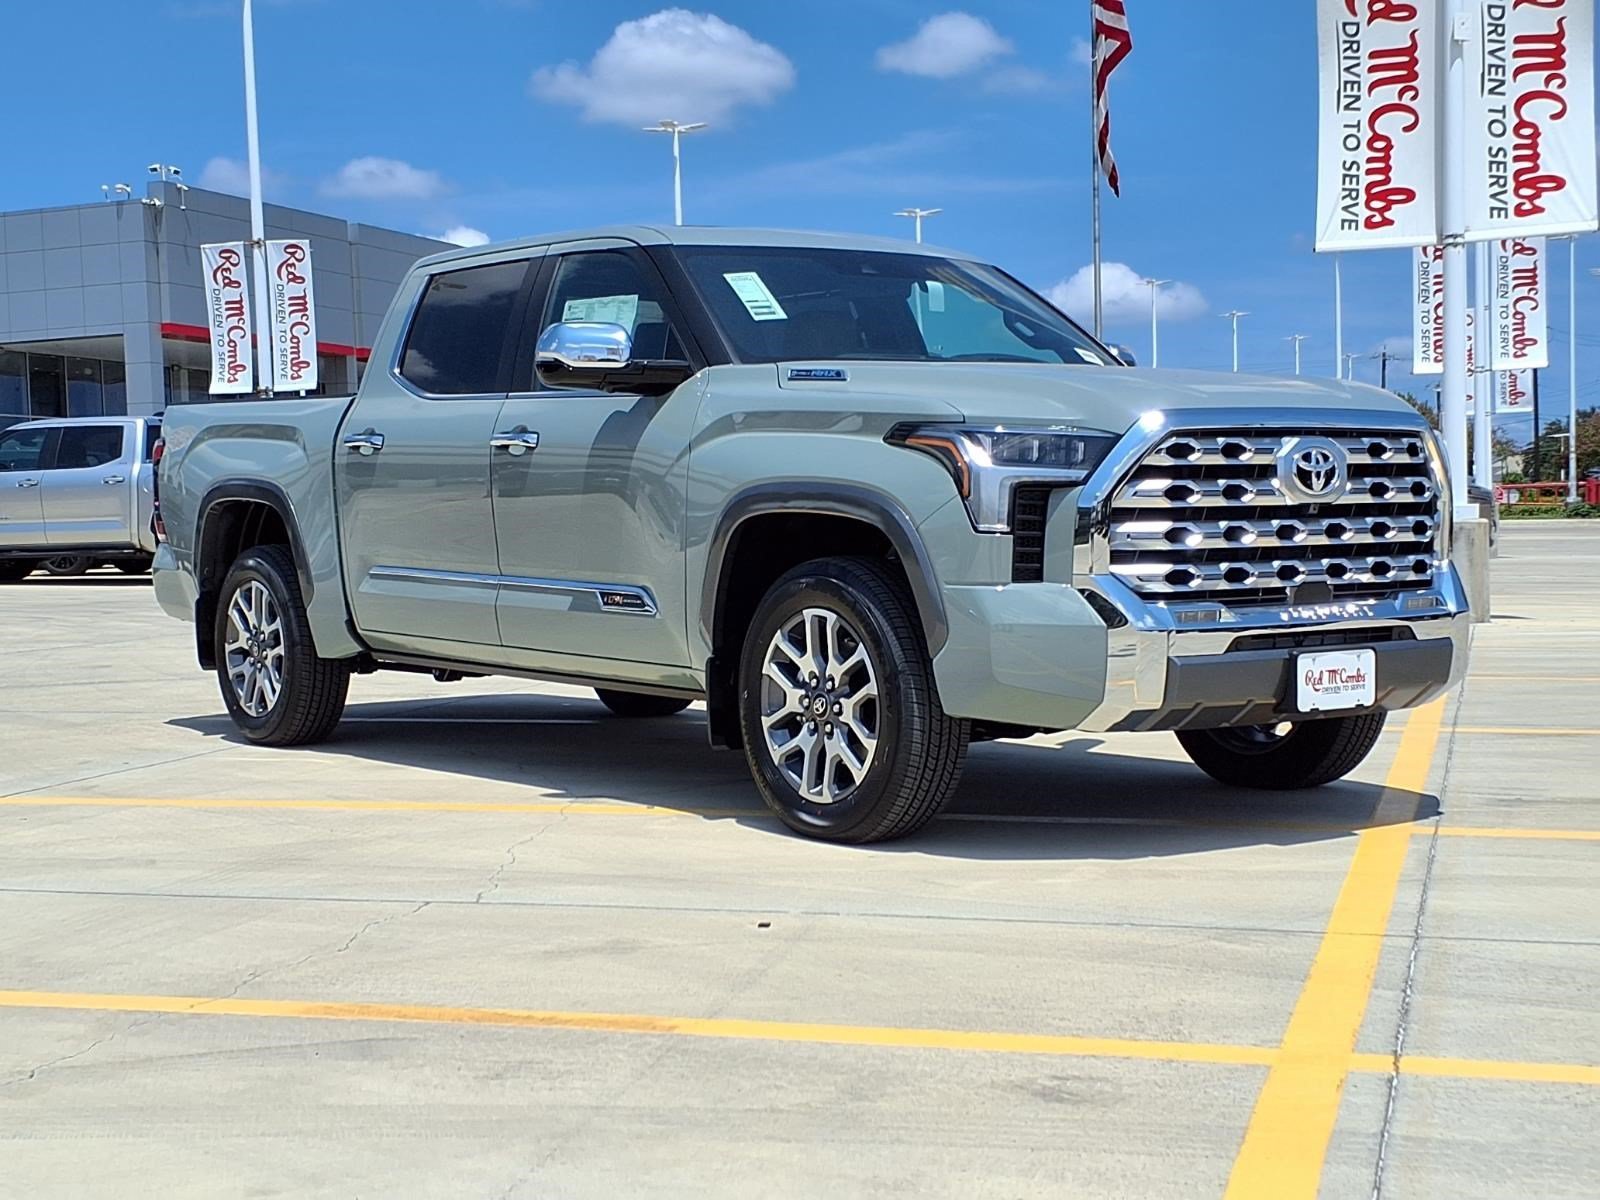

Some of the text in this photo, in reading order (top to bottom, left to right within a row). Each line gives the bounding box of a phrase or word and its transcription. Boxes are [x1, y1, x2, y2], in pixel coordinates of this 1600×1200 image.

[1341, 22, 1361, 231] DRIVEN TO SERVE
[1363, 28, 1419, 230] McCombs
[1486, 4, 1508, 220] DRIVEN TO SERVE
[1512, 16, 1568, 218] McCombs
[212, 248, 247, 384] Red McCombs
[212, 288, 226, 383] DRIVEN TO SERVE
[276, 243, 311, 381] Red McCombs
[276, 283, 288, 380] DRIVEN TO SERVE
[1420, 260, 1431, 363] DRIVEN TO SERVE
[1499, 255, 1510, 359] DRIVEN TO SERVE
[1511, 258, 1539, 359] McCombs
[1305, 667, 1367, 692] Red McCombs
